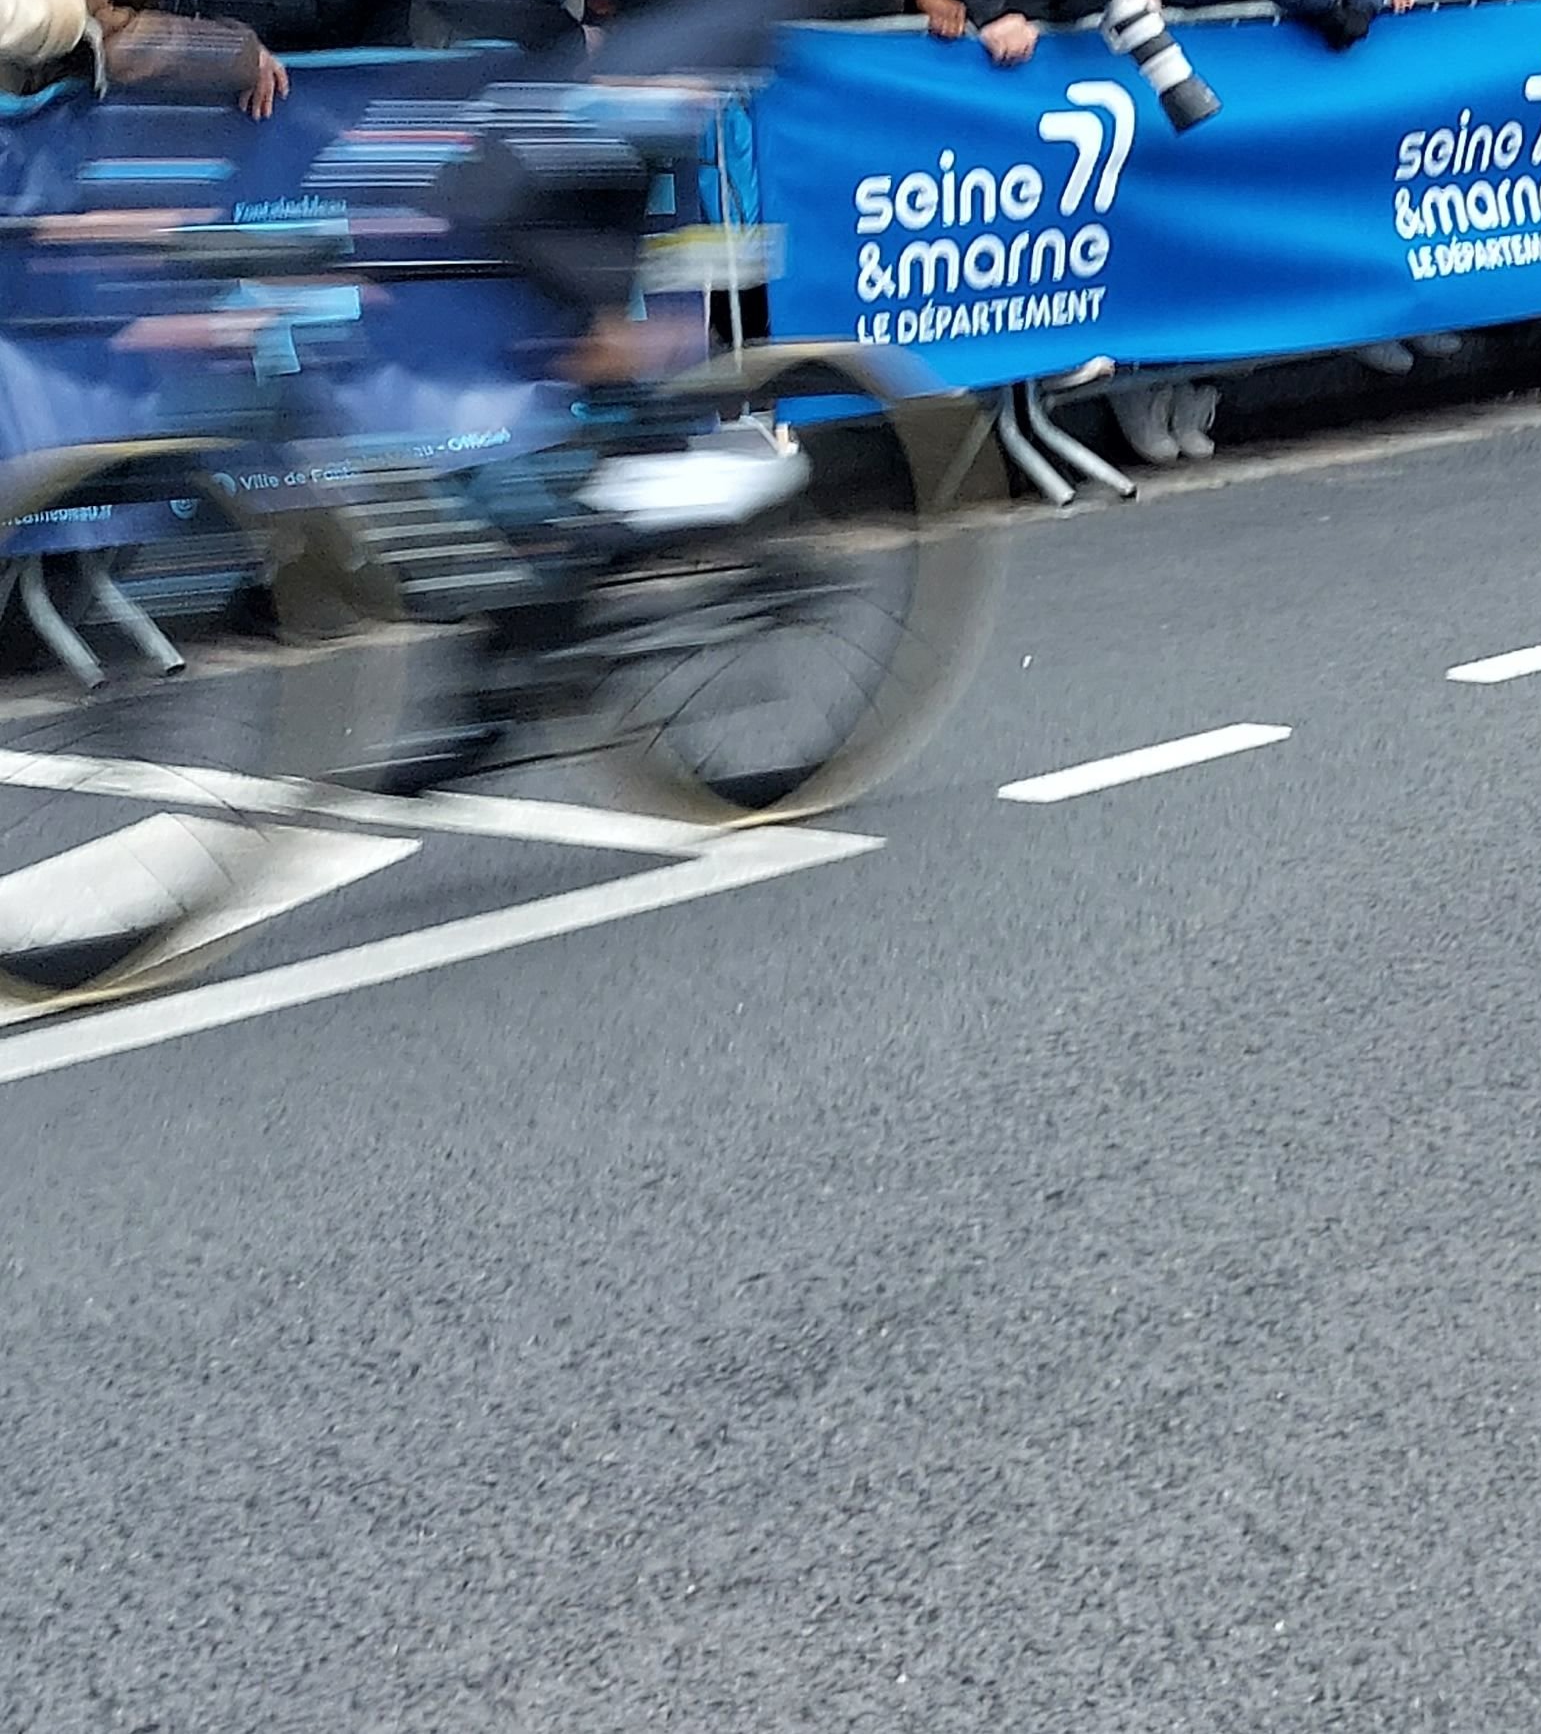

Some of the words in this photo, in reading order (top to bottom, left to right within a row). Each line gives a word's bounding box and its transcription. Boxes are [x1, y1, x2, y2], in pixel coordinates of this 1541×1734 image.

[1039, 80, 1135, 217] 77
[1395, 108, 1523, 181] seine
[855, 148, 1043, 234] seine
[1408, 245, 1436, 280] LE
[857, 311, 891, 344] LE
[897, 286, 1106, 344] DÉPARTEMENT
